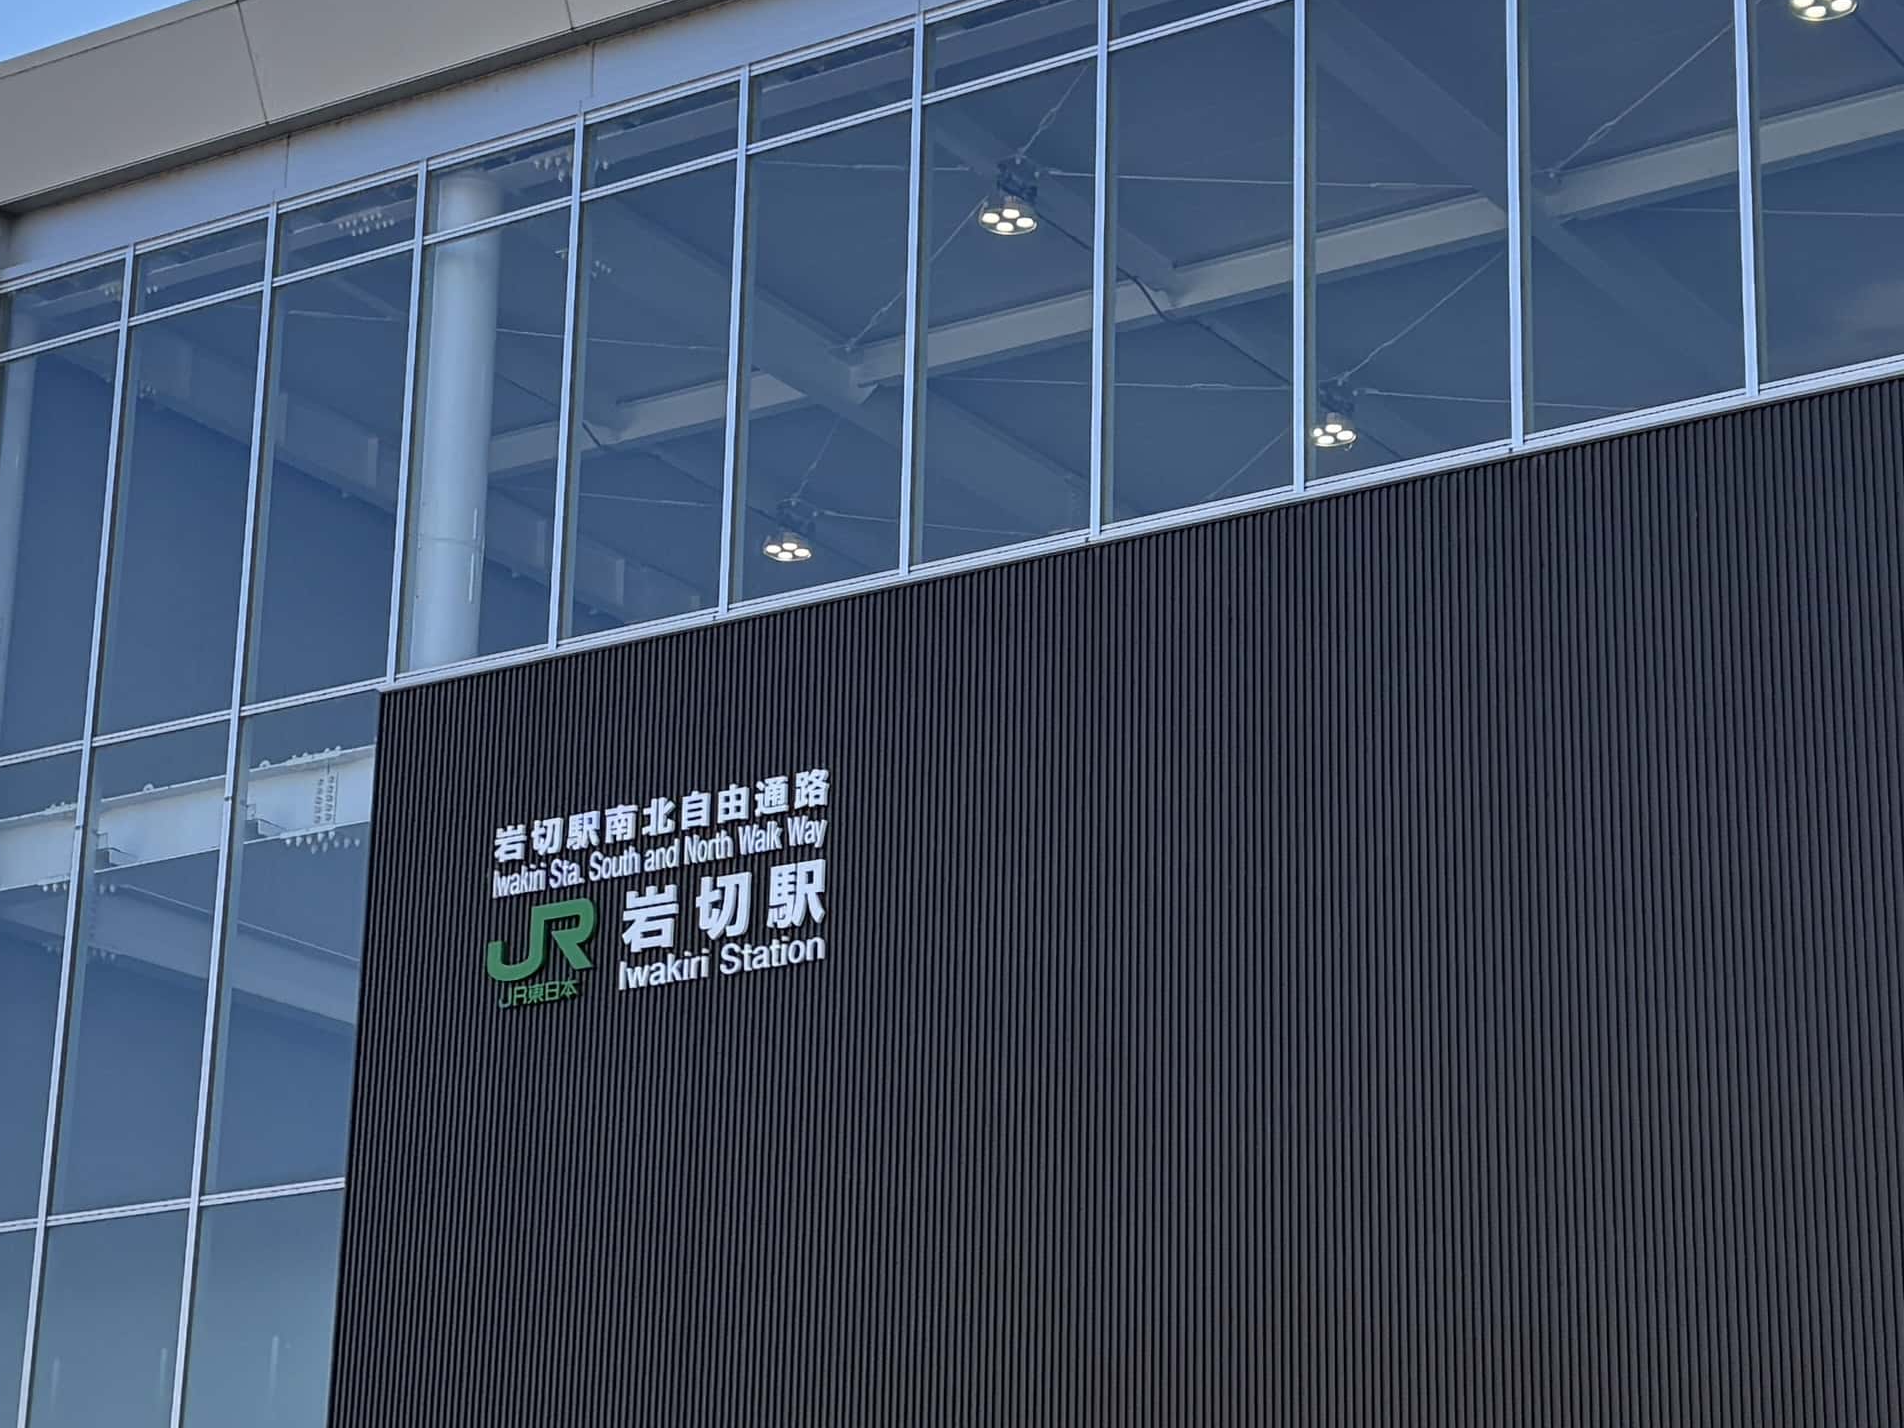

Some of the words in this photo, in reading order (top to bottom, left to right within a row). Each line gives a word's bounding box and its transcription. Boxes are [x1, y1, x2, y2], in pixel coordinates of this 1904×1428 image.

[492, 862, 546, 899] Iwakiri
[549, 857, 585, 889] Sta.
[590, 846, 641, 882] South
[644, 840, 680, 873] and
[684, 831, 734, 867] North
[738, 822, 782, 857] Walk
[787, 815, 828, 849] Way
[493, 769, 830, 863] 岩切駅南北自由通路
[486, 897, 596, 982] JR
[621, 858, 827, 954] 岩切駅
[498, 980, 579, 1008] JR東日本
[618, 948, 710, 991] Iwakiri
[719, 935, 826, 976] Station
